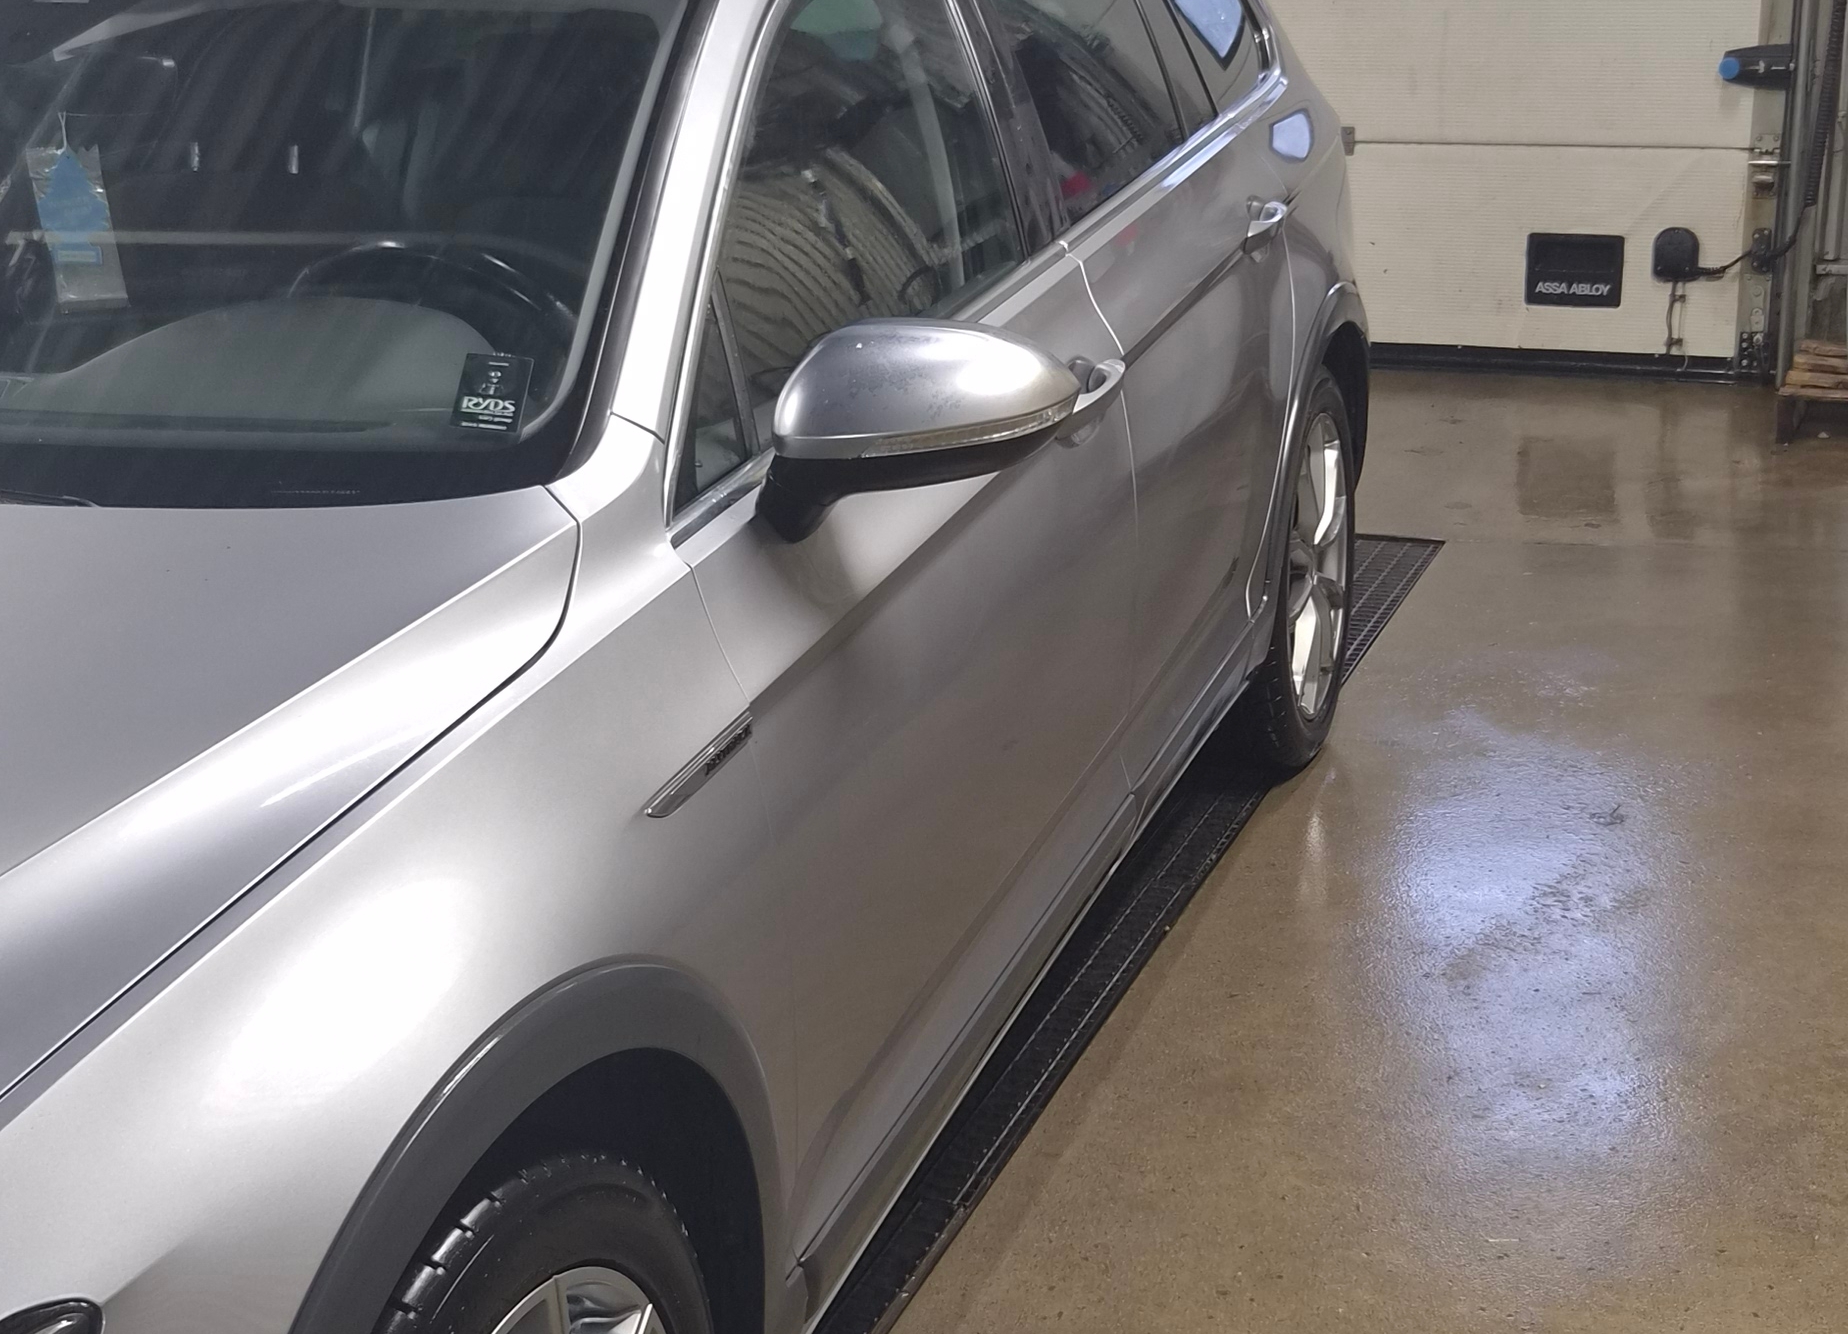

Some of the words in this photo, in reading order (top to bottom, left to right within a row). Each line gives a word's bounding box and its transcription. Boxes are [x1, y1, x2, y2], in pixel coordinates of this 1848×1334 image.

[1535, 281, 1568, 295] ASSA
[1569, 282, 1611, 296] ABLOY
[461, 396, 516, 413] RYDS
